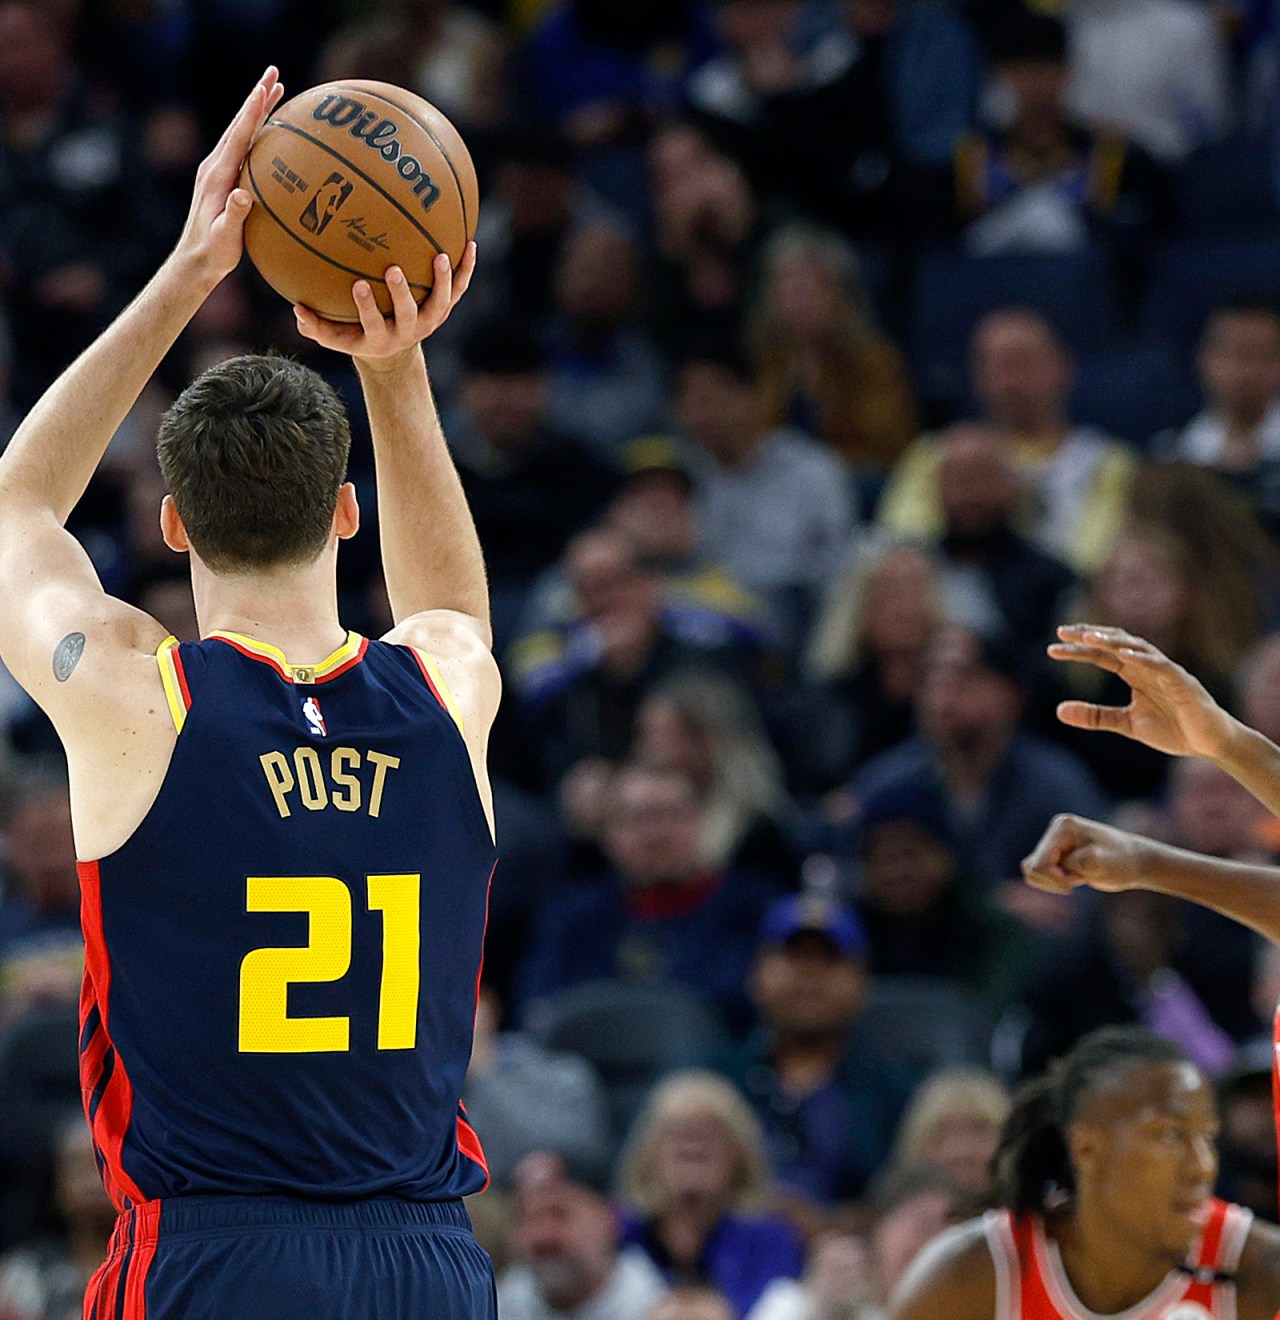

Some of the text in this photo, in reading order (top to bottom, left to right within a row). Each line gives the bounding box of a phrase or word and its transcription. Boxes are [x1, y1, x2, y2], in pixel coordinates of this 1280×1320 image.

[312, 94, 441, 213] Wilson
[259, 747, 400, 818] POST
[238, 873, 421, 1053] 21
